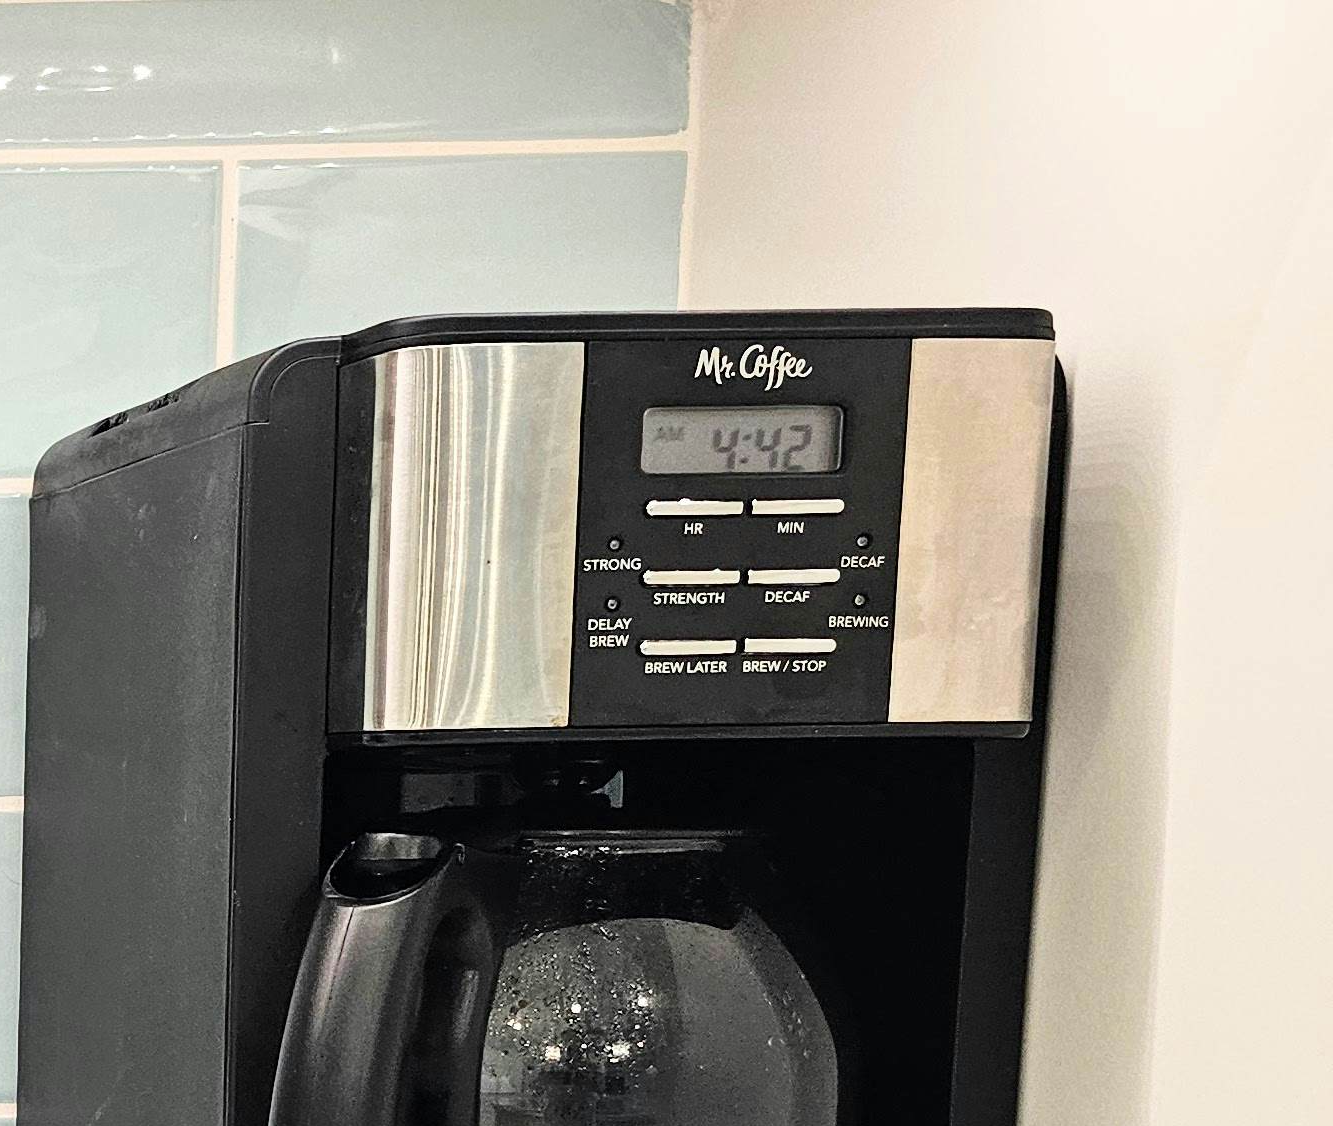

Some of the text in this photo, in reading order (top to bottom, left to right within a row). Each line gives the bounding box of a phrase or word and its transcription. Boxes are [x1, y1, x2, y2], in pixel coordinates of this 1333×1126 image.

[694, 343, 813, 392] Mr. Coffee
[712, 424, 812, 471] 4:42
[683, 522, 704, 535] HR
[777, 521, 805, 534] MIN
[583, 557, 642, 572] STRONG
[840, 555, 886, 569] DECAF
[653, 591, 726, 606] STRENGTH
[764, 590, 811, 603] DECAF
[587, 617, 633, 631] DELAY
[828, 615, 889, 629] BREWING
[589, 634, 630, 648] BREW
[644, 660, 728, 674] BREW LATER
[742, 660, 781, 673] BREW
[791, 659, 827, 673] STOP
